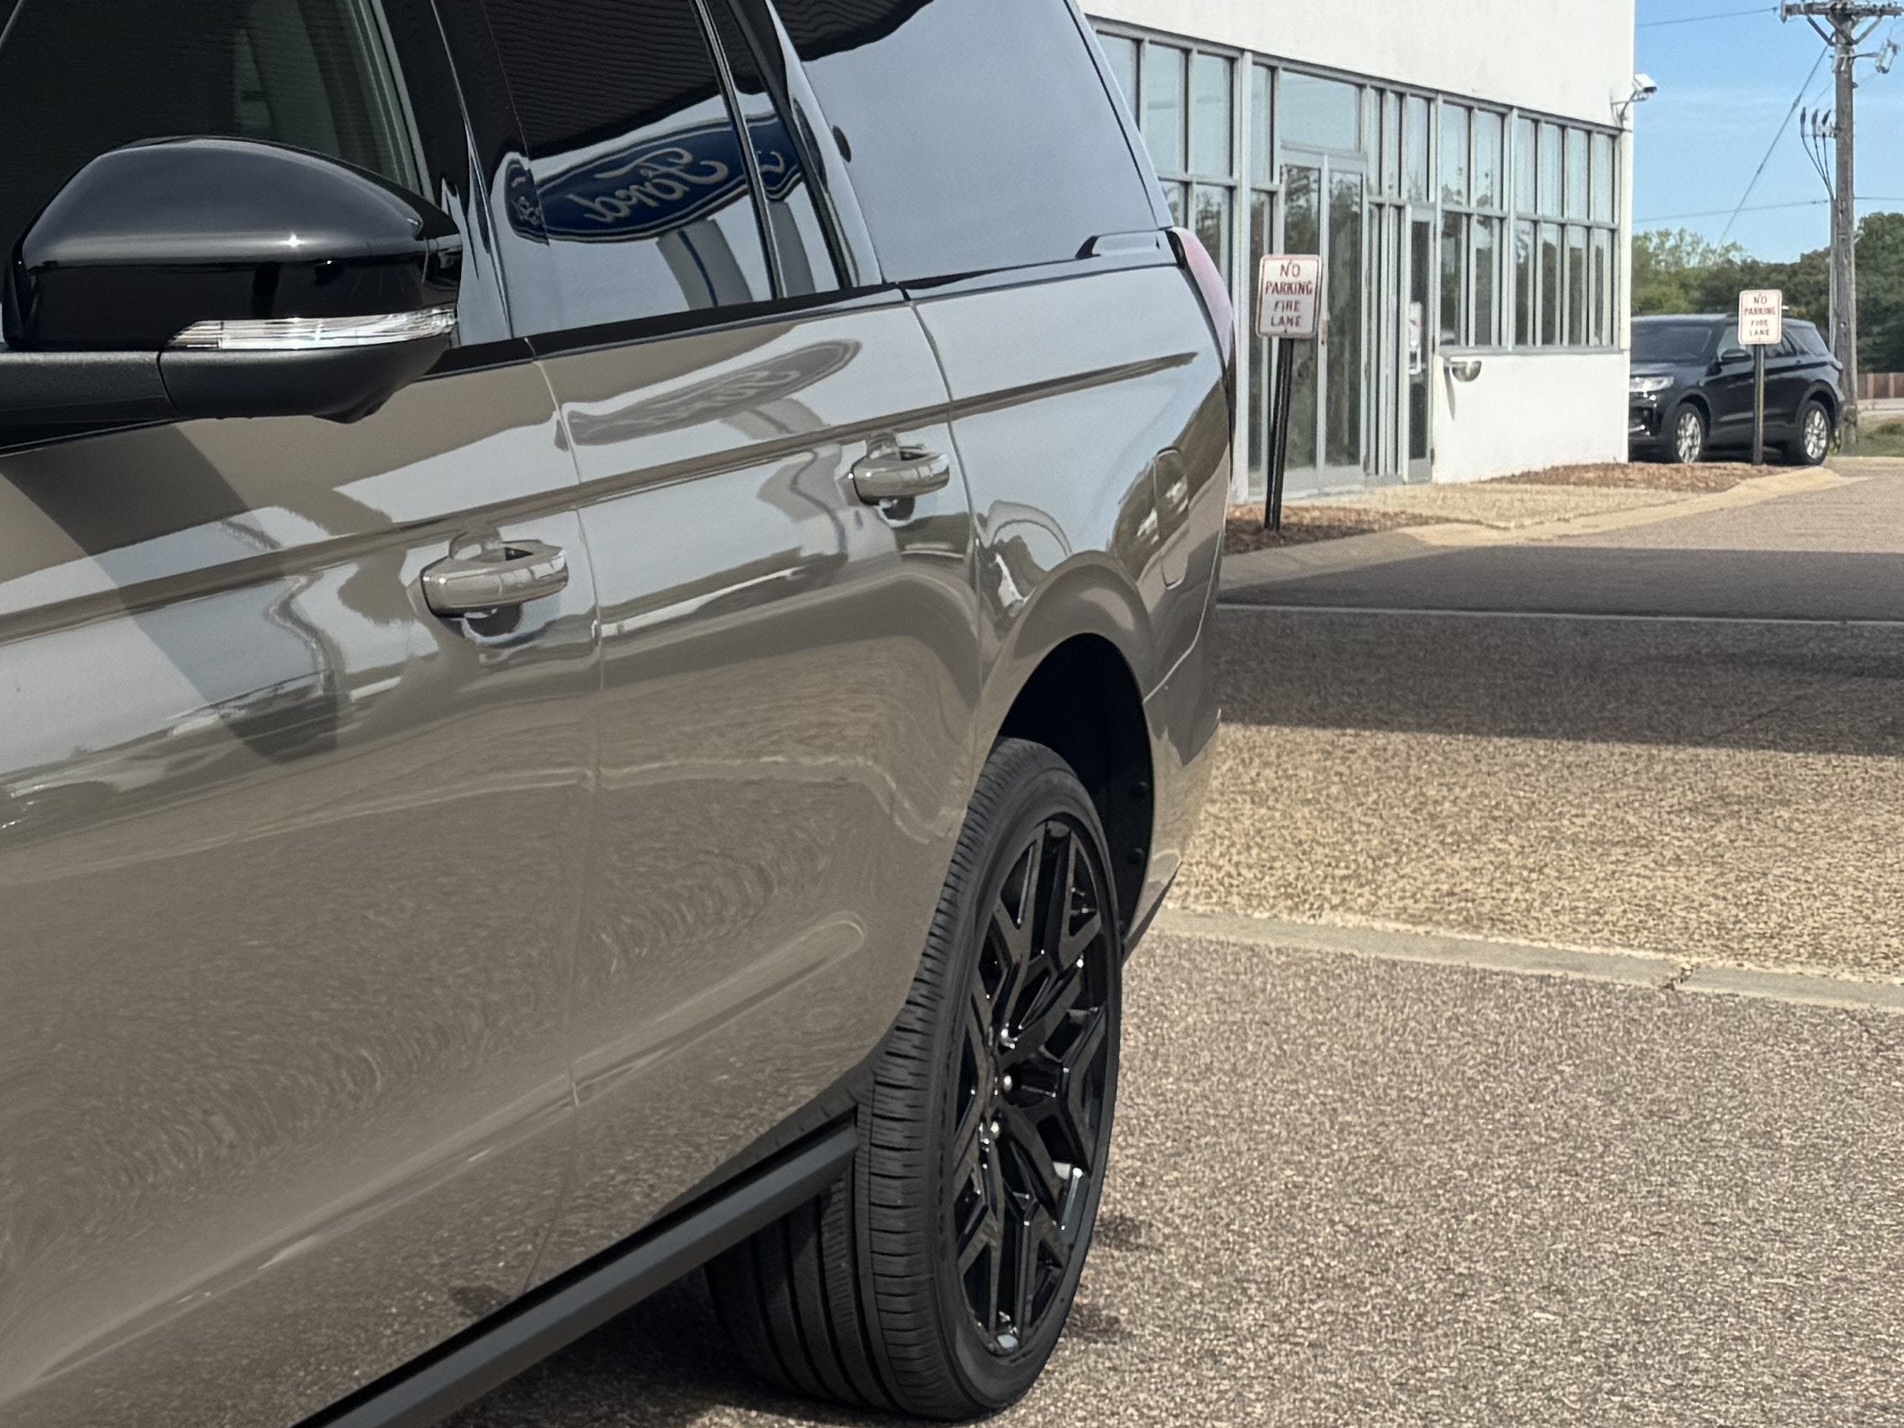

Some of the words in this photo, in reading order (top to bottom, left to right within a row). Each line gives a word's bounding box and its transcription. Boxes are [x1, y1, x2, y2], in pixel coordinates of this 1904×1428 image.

[1280, 262, 1301, 278] NO
[1265, 280, 1313, 296] PARKING
[1274, 300, 1302, 312] FIRE
[1754, 296, 1768, 305] NO
[1270, 315, 1302, 327] LANE
